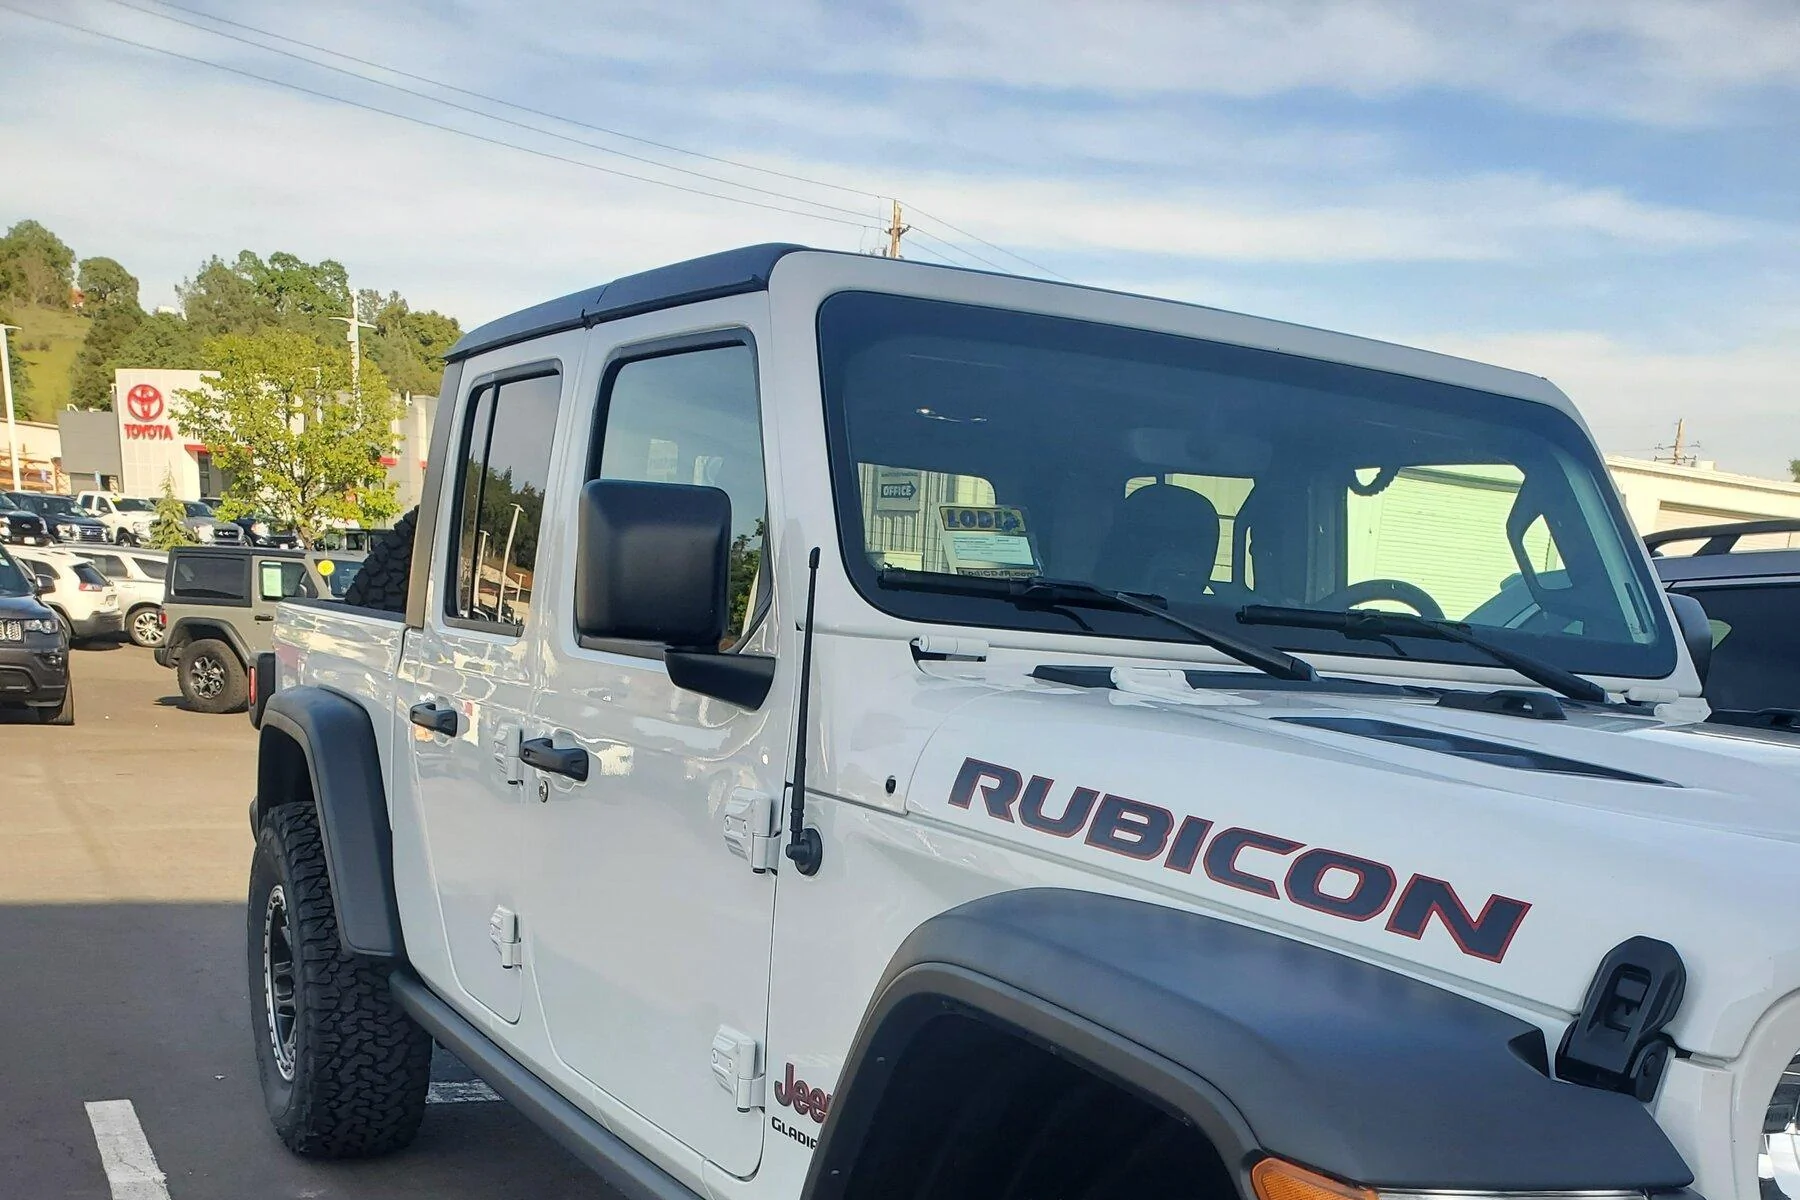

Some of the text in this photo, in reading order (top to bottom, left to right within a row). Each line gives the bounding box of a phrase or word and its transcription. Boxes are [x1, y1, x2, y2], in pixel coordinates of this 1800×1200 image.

[124, 423, 173, 440] TOYOTA
[883, 485, 912, 496] OFFICE
[948, 757, 1533, 964] RUBICON
[774, 1062, 833, 1124] Jee
